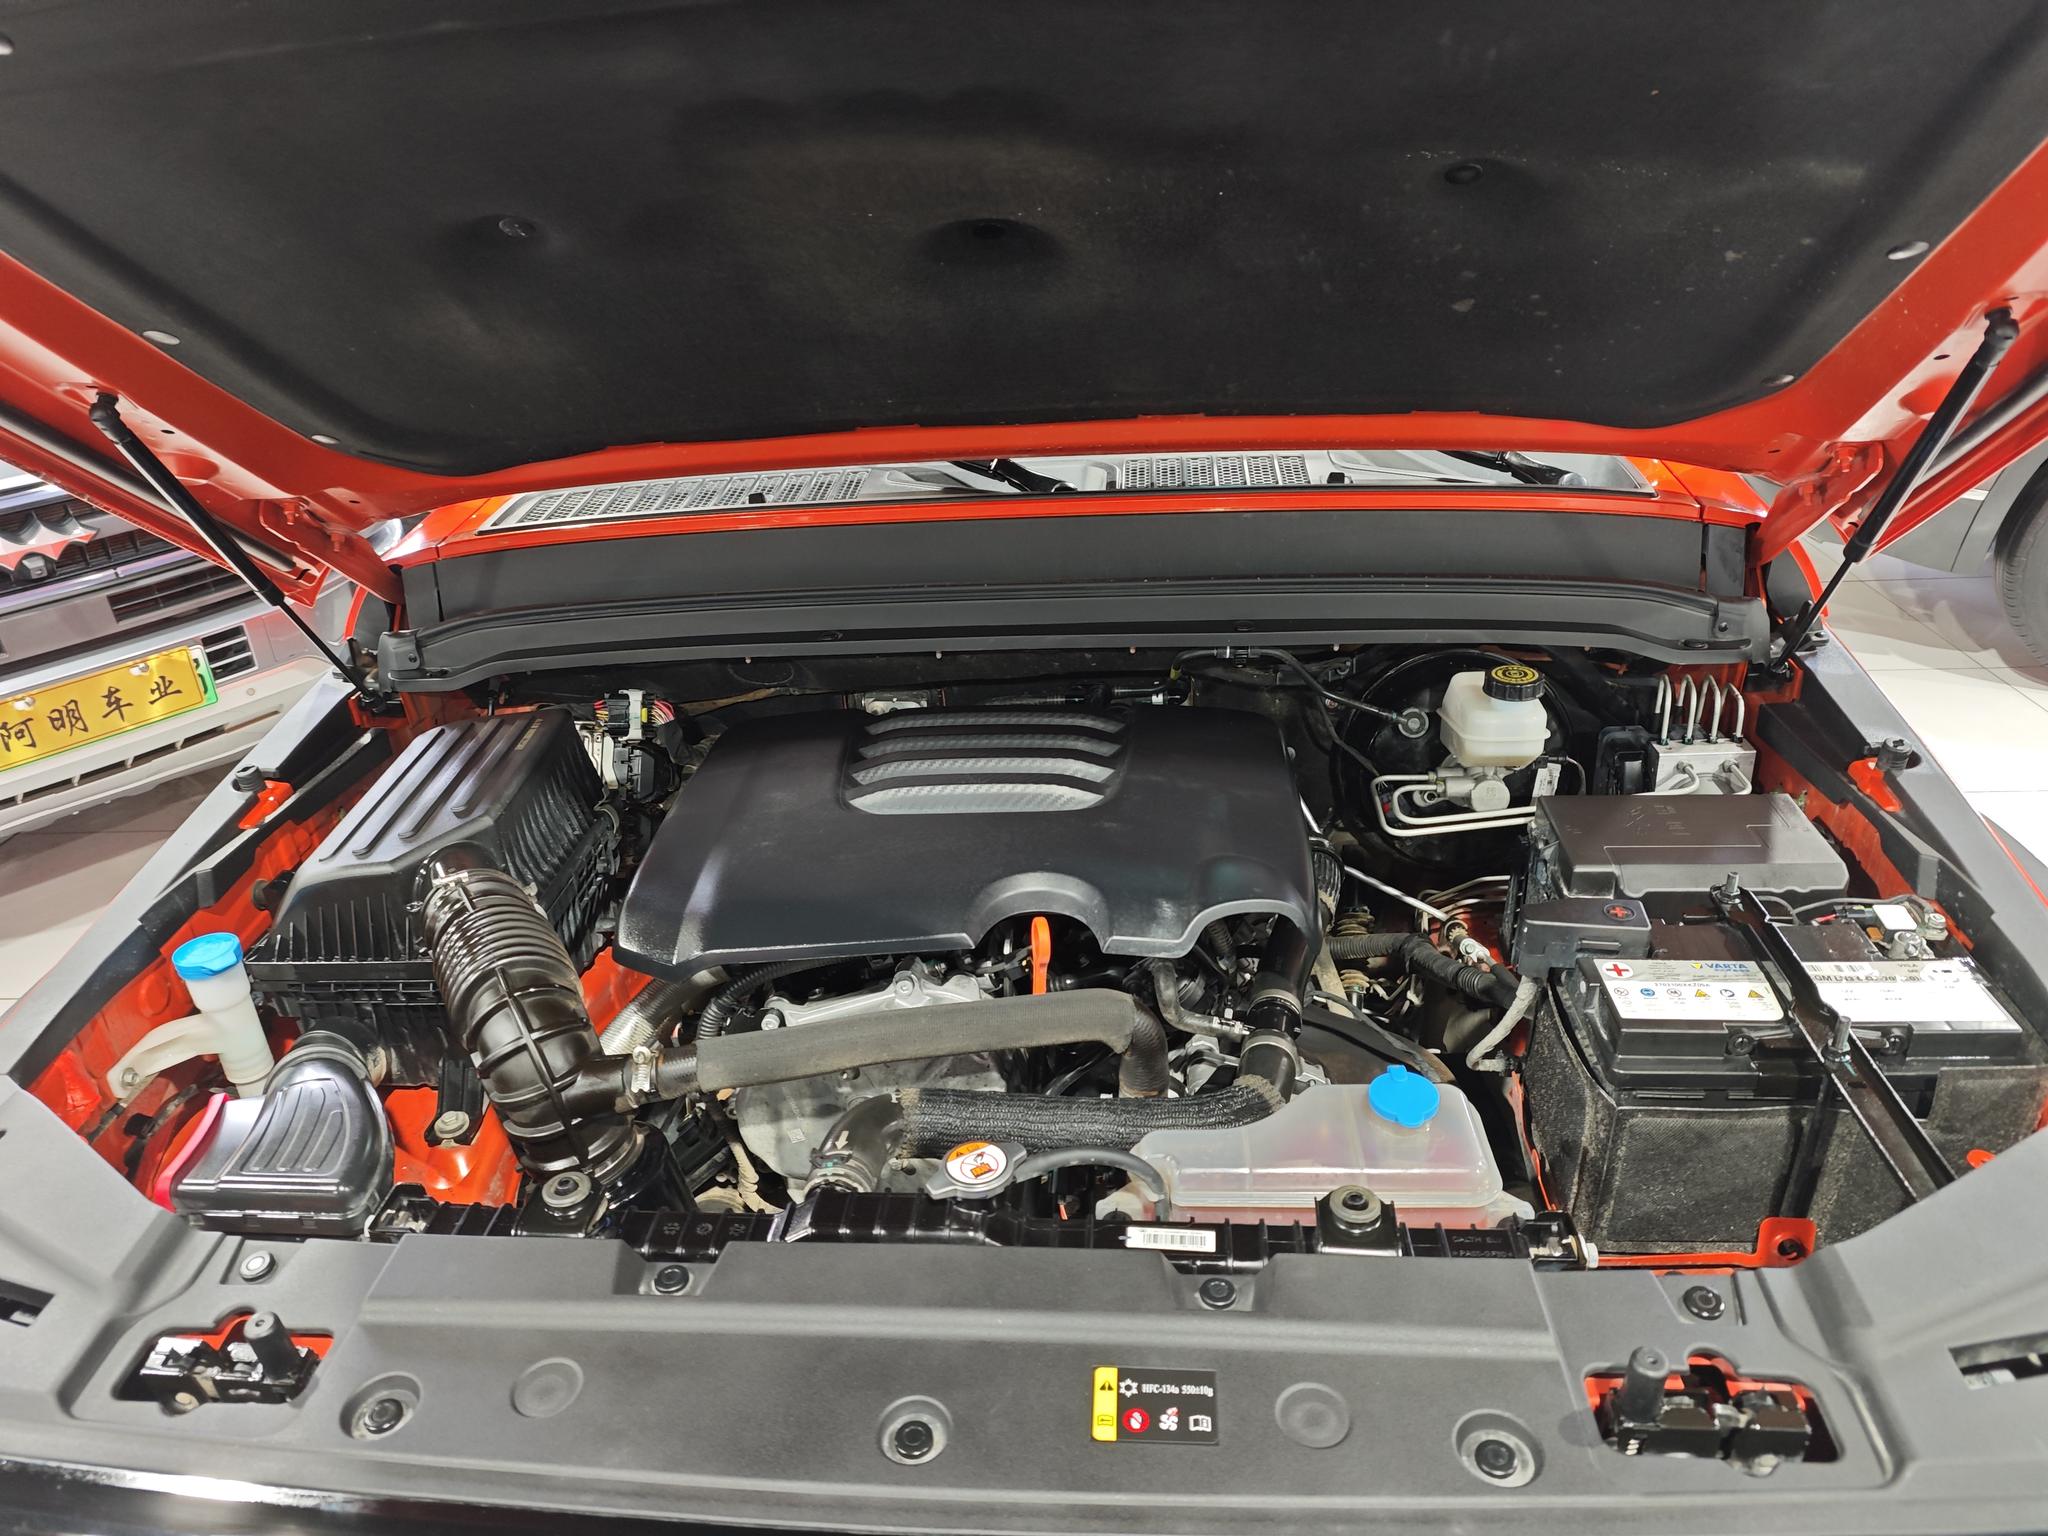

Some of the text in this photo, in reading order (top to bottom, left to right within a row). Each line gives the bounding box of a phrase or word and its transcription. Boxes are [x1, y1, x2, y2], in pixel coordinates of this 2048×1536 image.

[0, 675, 183, 753] 阿明车业
[1141, 1383, 1180, 1394] HFC-134a
